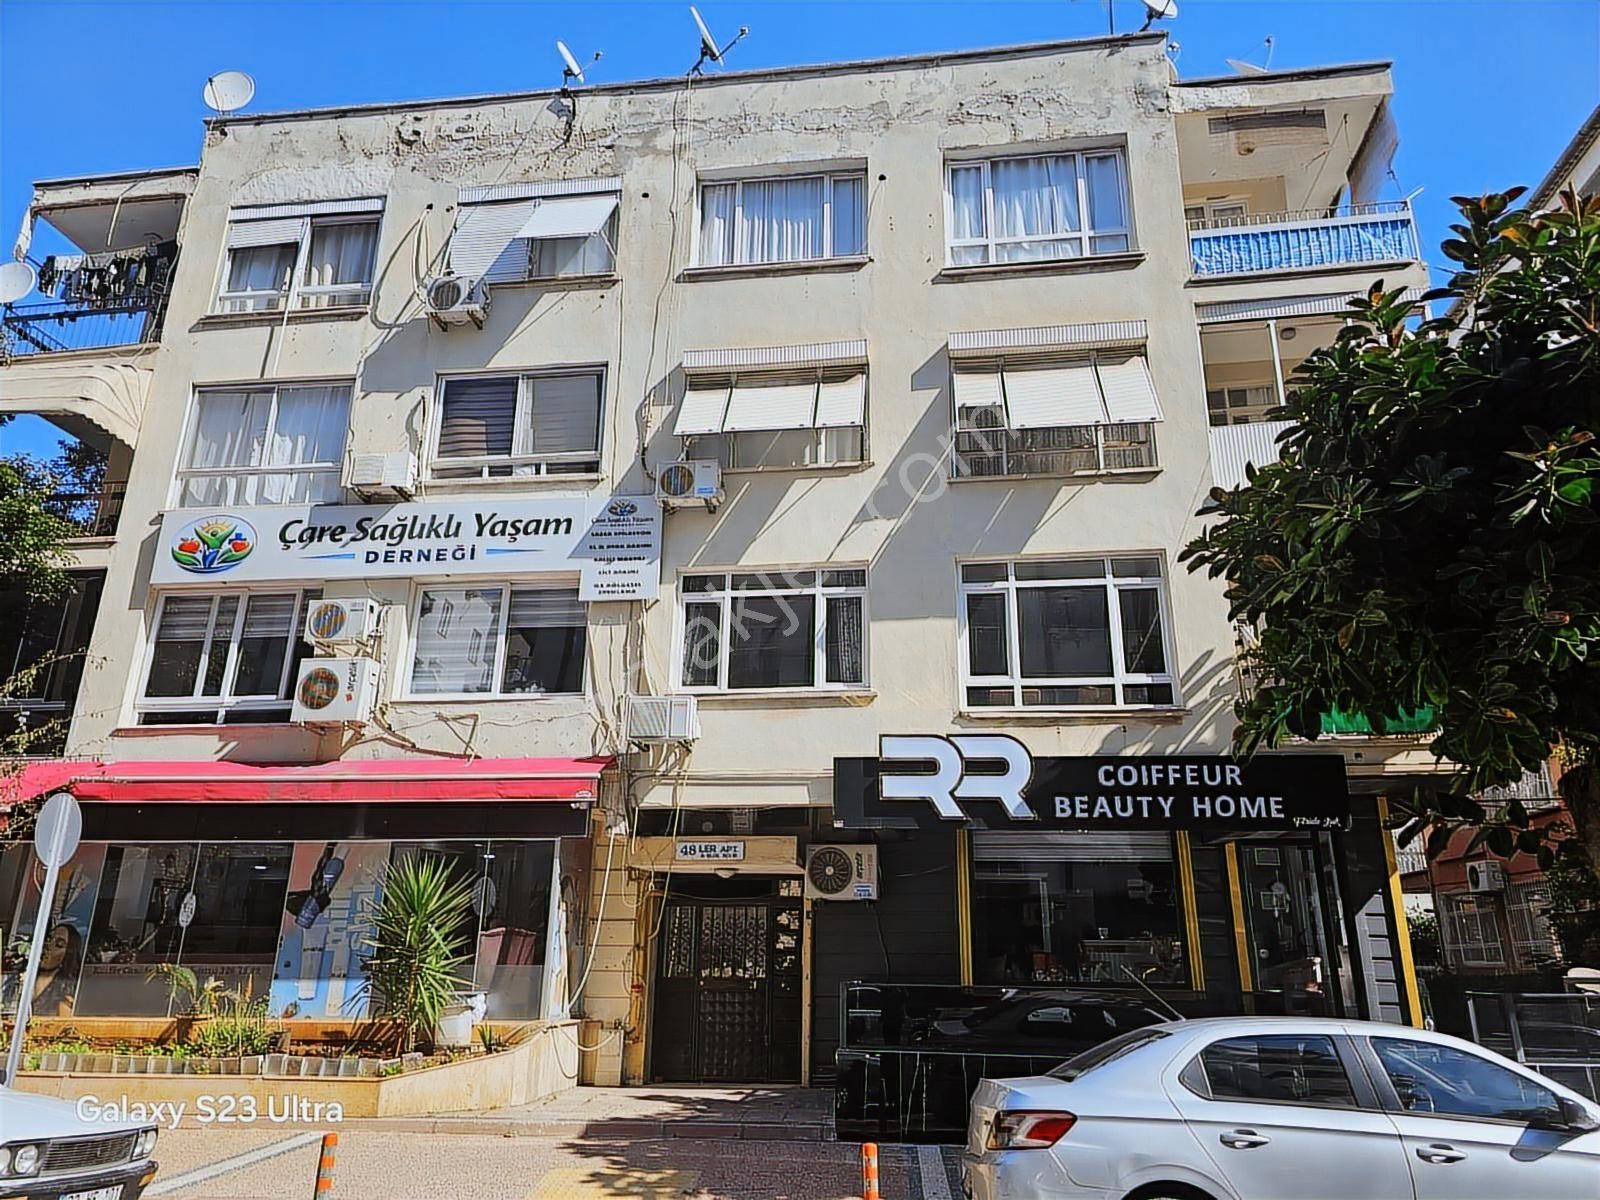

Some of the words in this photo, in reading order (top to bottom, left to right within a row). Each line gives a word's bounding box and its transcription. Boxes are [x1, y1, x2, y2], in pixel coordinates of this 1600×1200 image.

[278, 519, 346, 551] Çare
[351, 511, 462, 548] Sağlıklı
[474, 511, 573, 544] Yaşam
[364, 545, 477, 564] DERNEĞİ
[1097, 763, 1243, 787] COIFFEUR
[1053, 795, 1173, 819] BEAUTY
[1192, 795, 1286, 818] HOME
[680, 845, 697, 856] 48
[699, 844, 717, 853] LER
